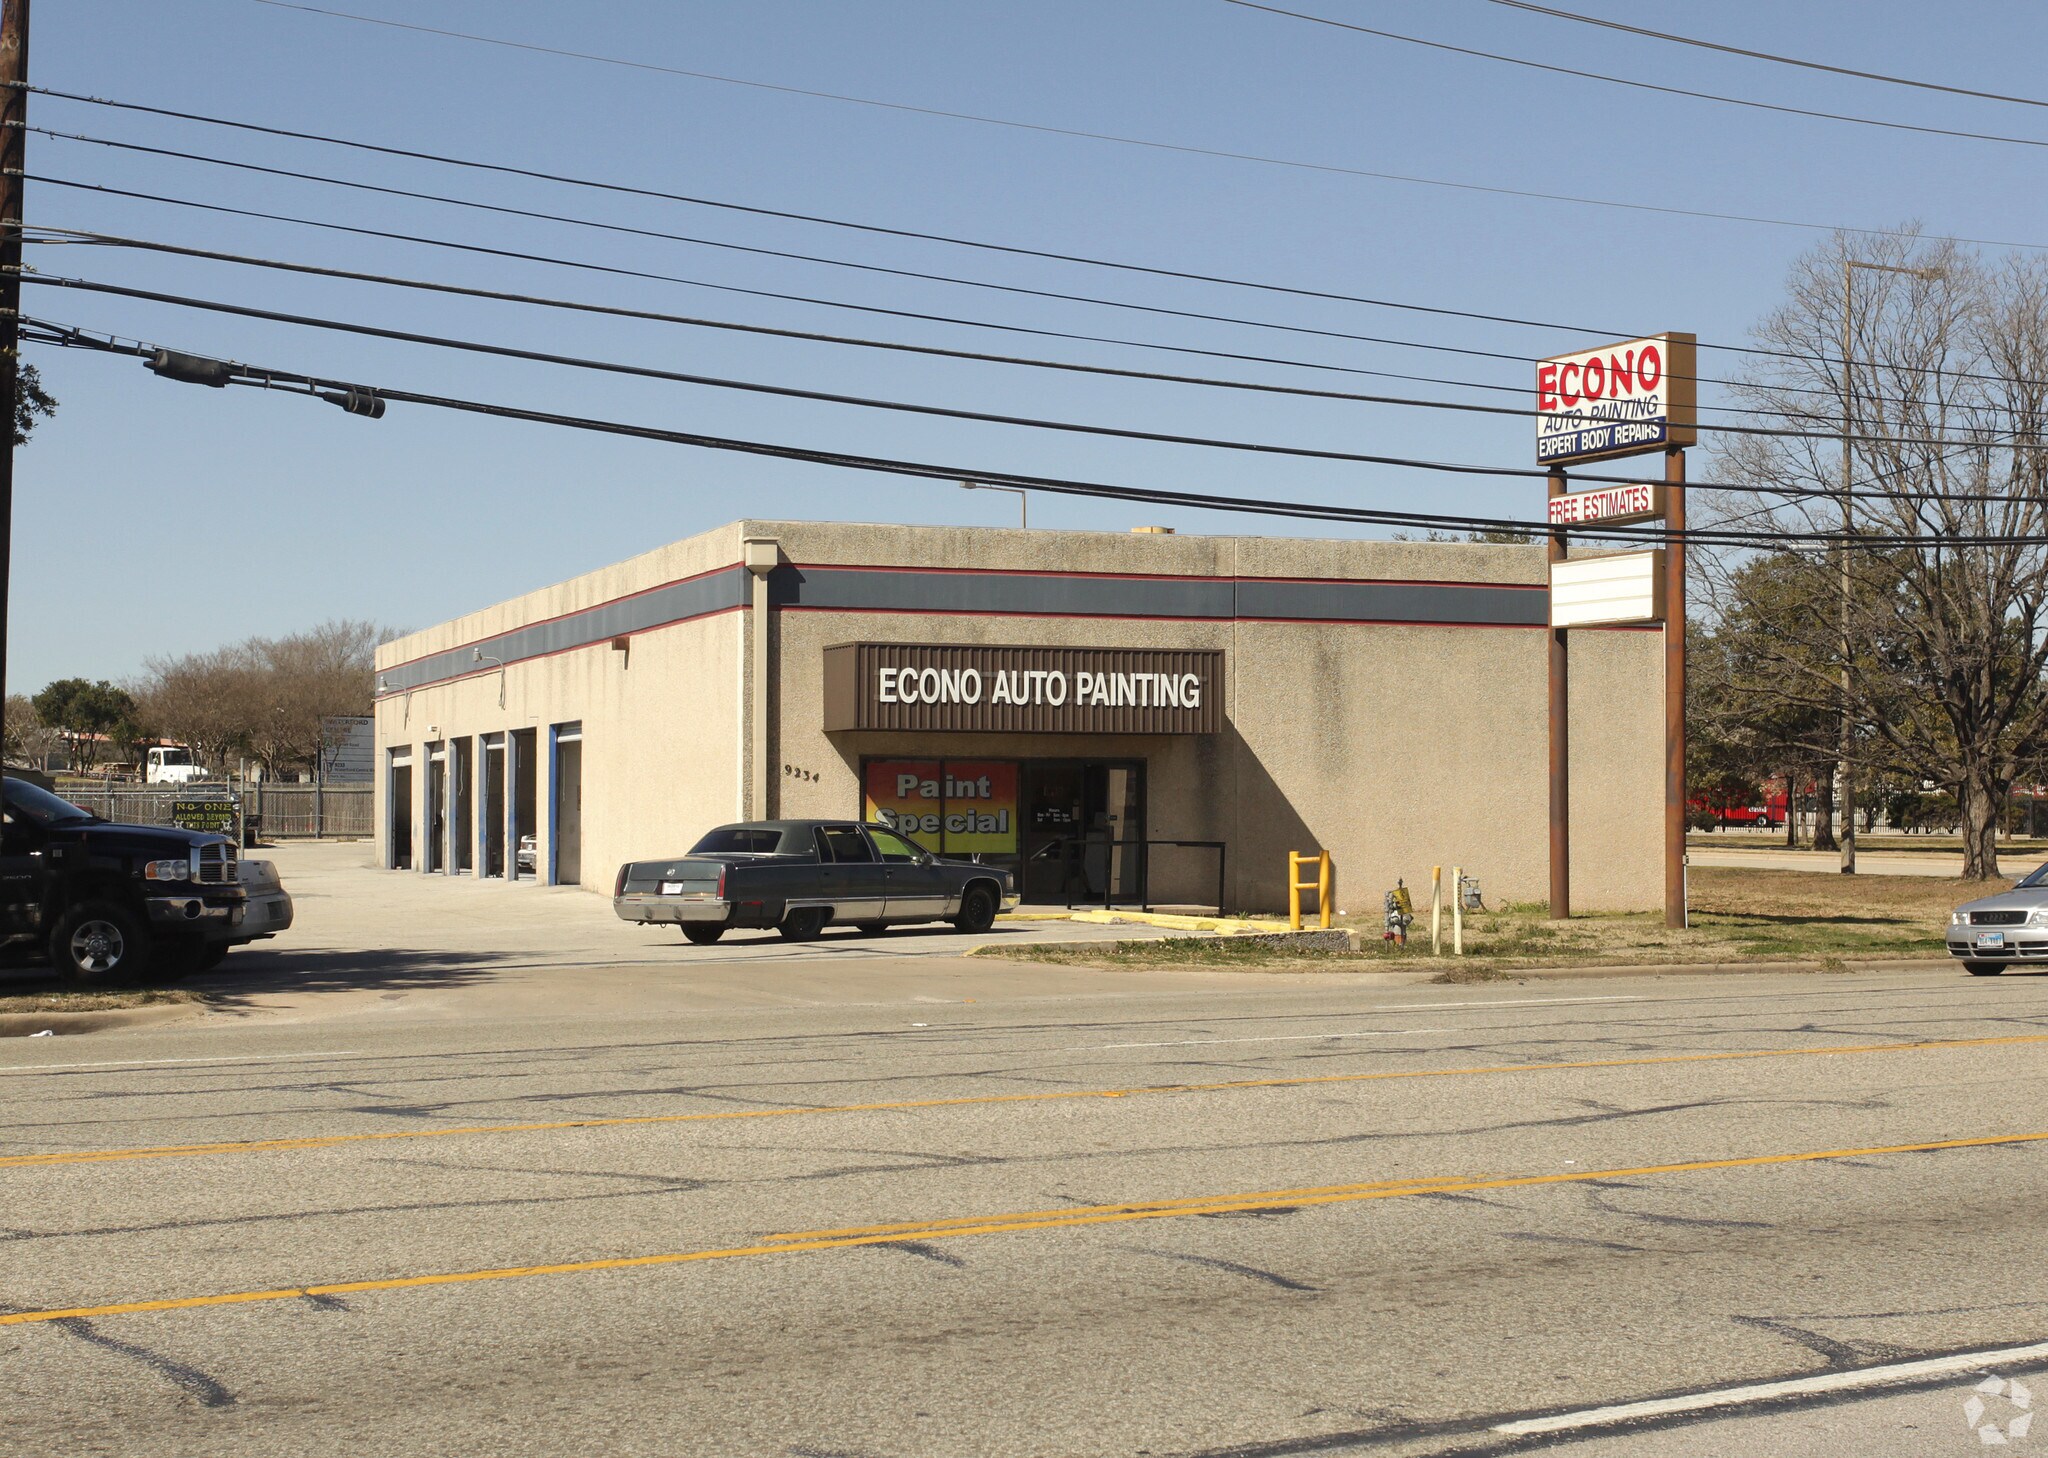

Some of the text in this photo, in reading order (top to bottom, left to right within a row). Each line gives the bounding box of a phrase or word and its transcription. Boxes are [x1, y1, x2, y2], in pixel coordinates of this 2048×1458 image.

[1538, 345, 1661, 411] ECONO
[1544, 394, 1658, 433] AUTO PAINTING
[1539, 420, 1660, 457] EXPERT BODY REPAIRS
[1549, 487, 1649, 524] FREE ESTIMATES
[879, 668, 1200, 708] ECONO AUTO PAINTING
[785, 764, 820, 783] 9234
[897, 775, 992, 800] Paint
[175, 813, 204, 821] ALLOWED
[176, 803, 232, 811] NO ONE
[201, 821, 220, 829] POINT
[875, 808, 1009, 834] Special
